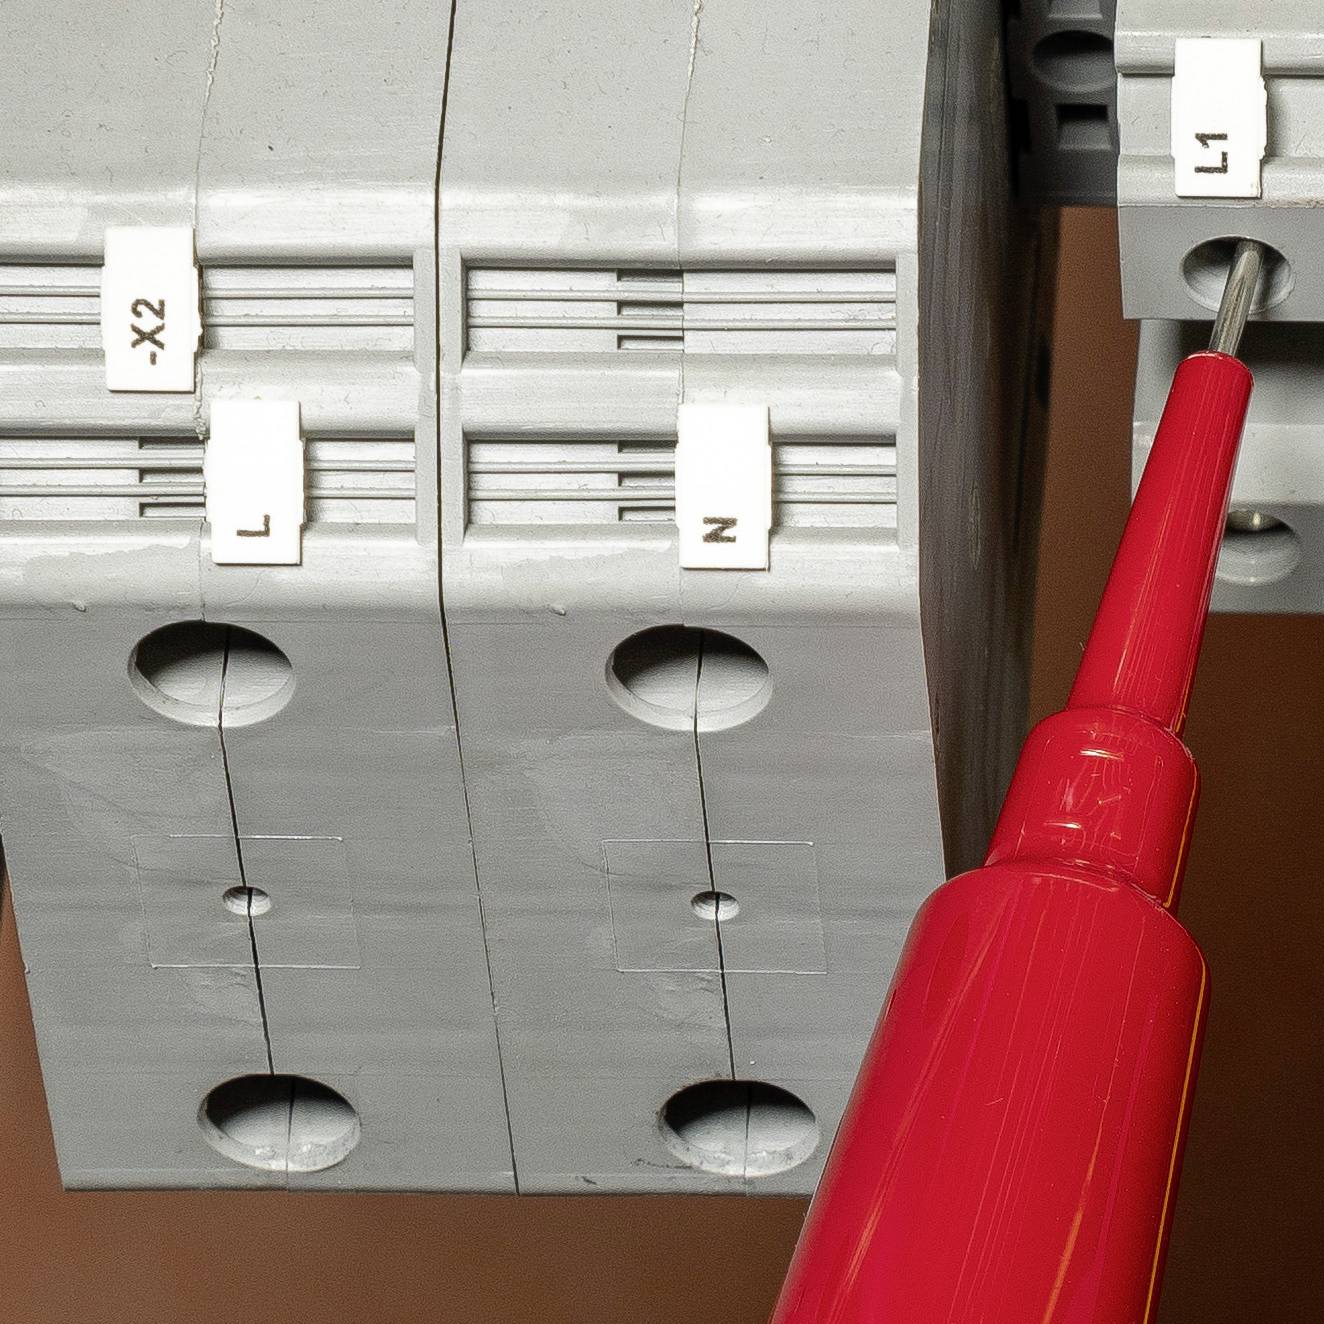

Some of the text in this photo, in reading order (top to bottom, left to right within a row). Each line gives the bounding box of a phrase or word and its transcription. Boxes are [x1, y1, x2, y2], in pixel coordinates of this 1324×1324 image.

[1194, 132, 1228, 174] L1
[131, 298, 166, 366] -X2
[236, 515, 271, 538] L
[703, 517, 737, 543] N
